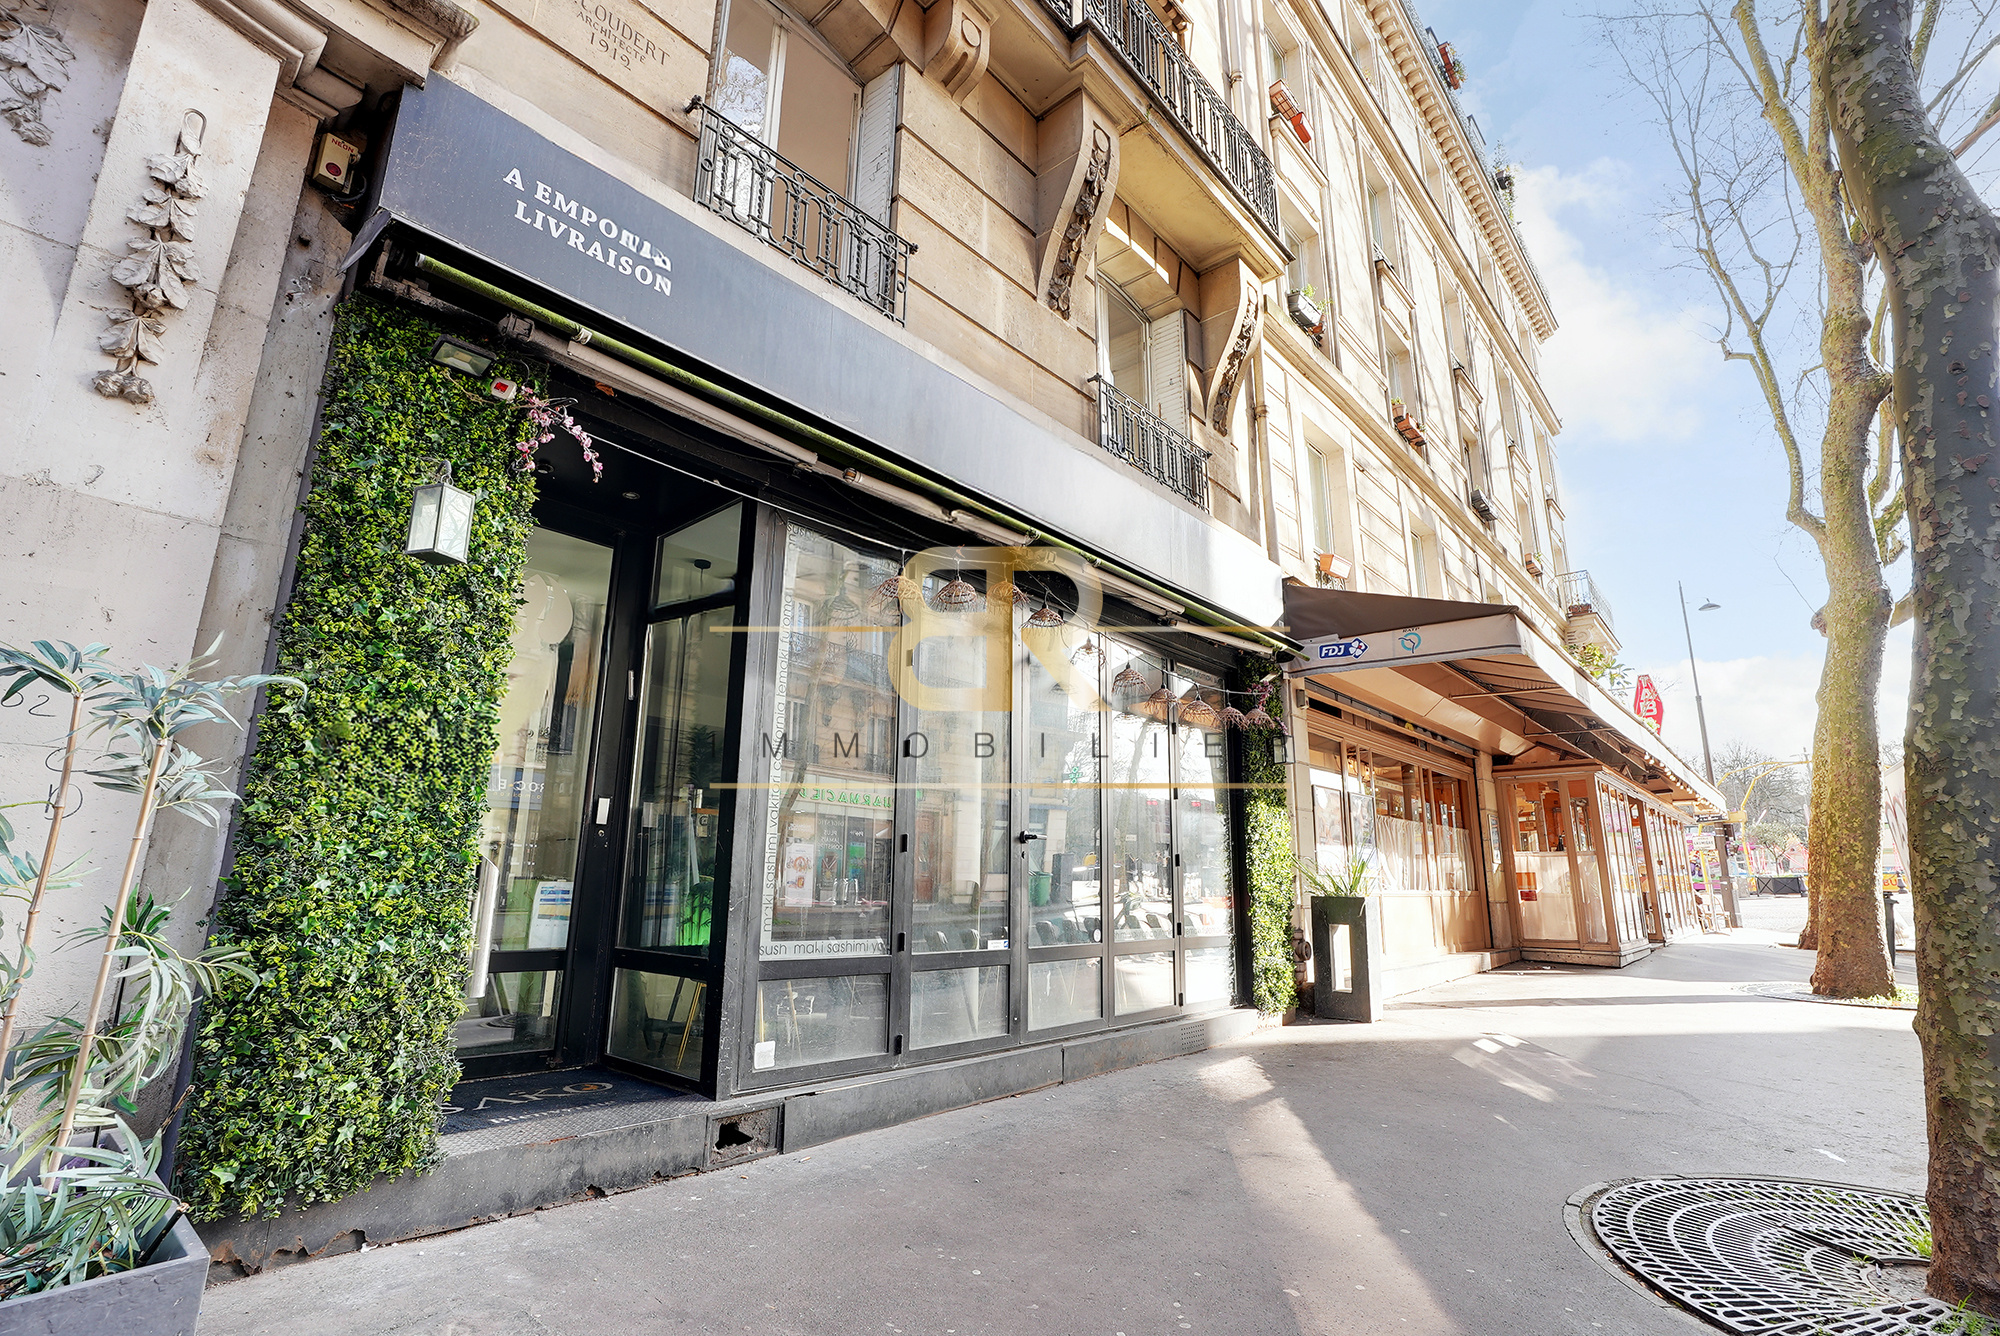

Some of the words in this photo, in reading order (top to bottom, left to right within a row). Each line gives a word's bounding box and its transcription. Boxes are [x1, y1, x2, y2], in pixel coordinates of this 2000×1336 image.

[576, 11, 647, 64] ARCHITECTE
[590, 32, 632, 71] 1912
[331, 138, 355, 153] NEON
[502, 167, 525, 192] A
[514, 200, 672, 297] LIVRAISON
[1321, 645, 1345, 657] FDJ
[776, 649, 790, 697] temaki
[772, 703, 786, 771] california
[765, 832, 778, 889] sashimi
[793, 942, 824, 955] maki
[827, 938, 869, 954] sashimi
